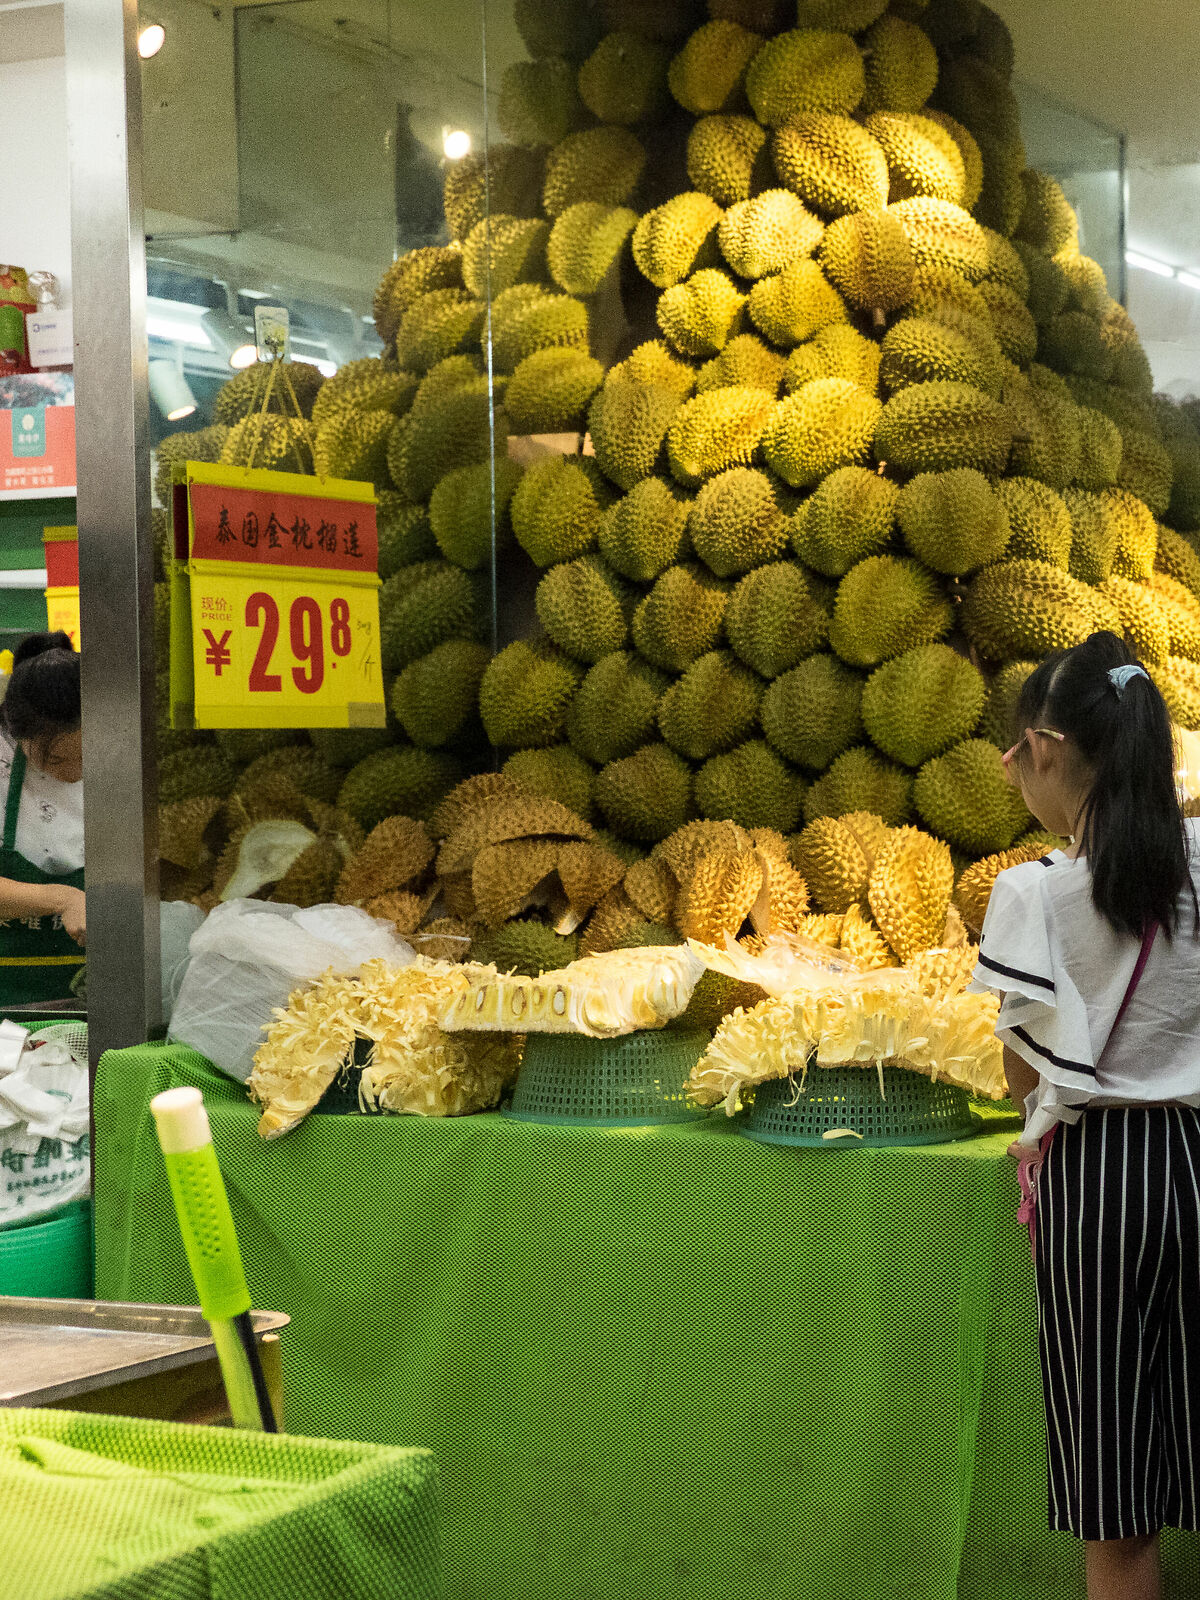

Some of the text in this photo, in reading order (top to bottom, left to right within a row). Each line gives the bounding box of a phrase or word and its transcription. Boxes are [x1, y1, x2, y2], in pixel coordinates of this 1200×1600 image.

[216, 505, 363, 558] 泰国金枕榴莲
[201, 612, 232, 621] PRICE
